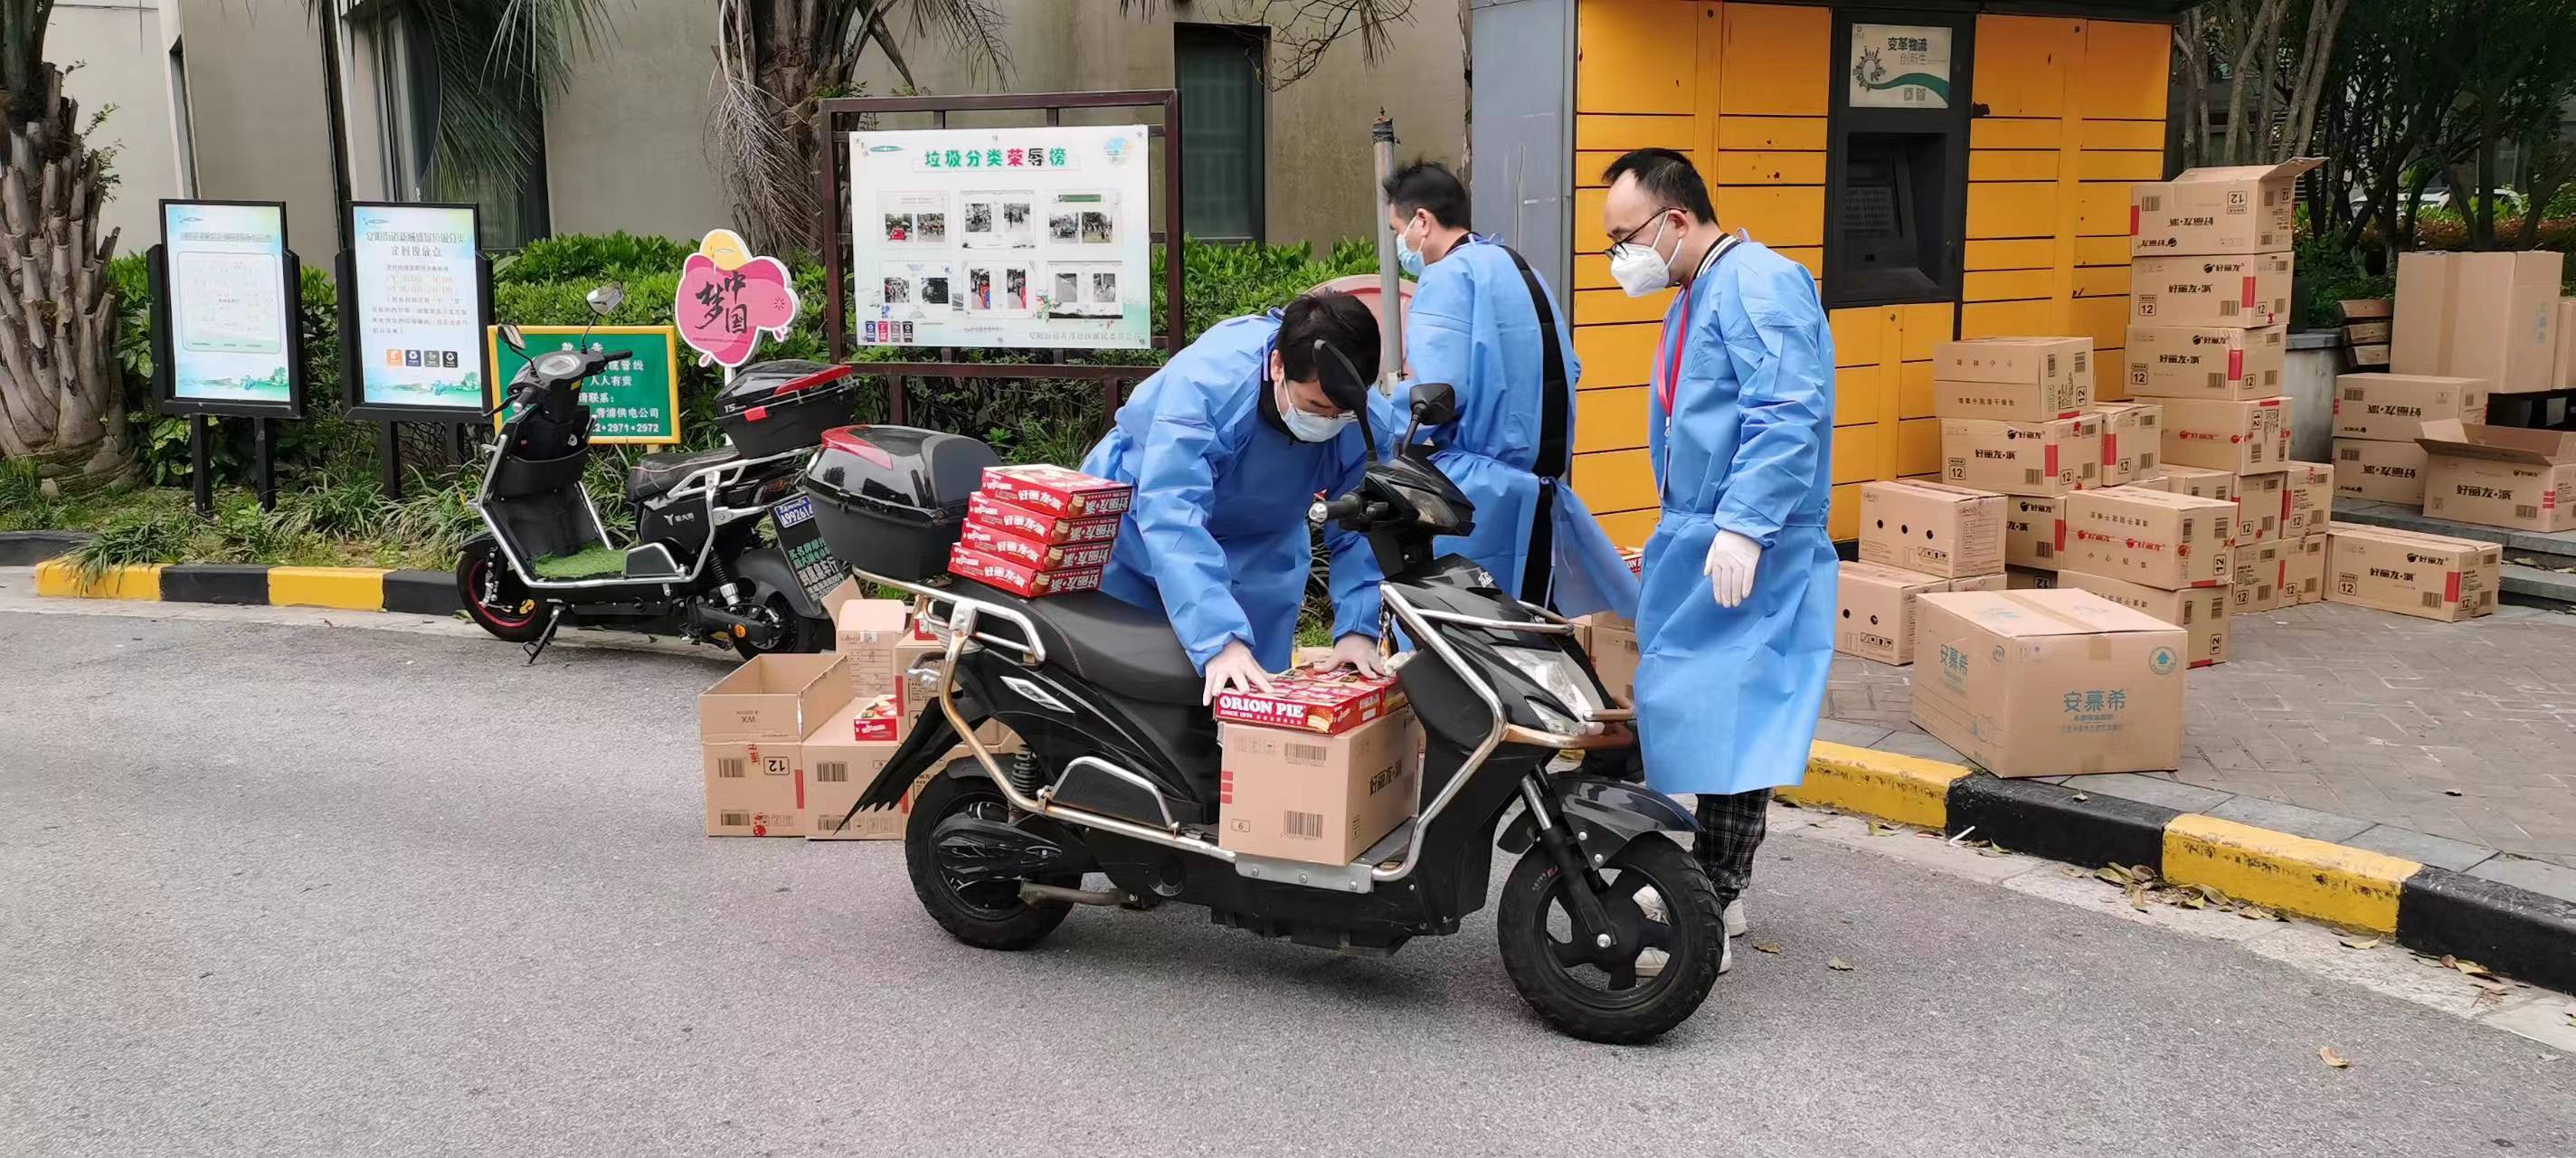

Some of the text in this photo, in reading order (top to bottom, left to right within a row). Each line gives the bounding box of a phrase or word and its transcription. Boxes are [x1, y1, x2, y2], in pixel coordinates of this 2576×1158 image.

[1888, 37, 1927, 52] 变革物流
[924, 147, 1066, 167] 垃圾分类荣辱榜
[2230, 194, 2243, 204] 12
[2141, 304, 2154, 314] 12
[605, 359, 644, 371] 缆管线
[590, 376, 632, 386] 人人有责
[2134, 373, 2145, 383] 12
[596, 408, 659, 419] 青浦供电公司
[1952, 468, 1963, 477] 12
[2062, 472, 2071, 482] 12
[2342, 583, 2353, 593] 12
[2238, 593, 2246, 603] 12
[1939, 643, 1968, 676] 安慕希
[2063, 689, 2126, 712] 安慕希
[1219, 694, 1304, 718] ORION PIE
[769, 759, 786, 772] 12
